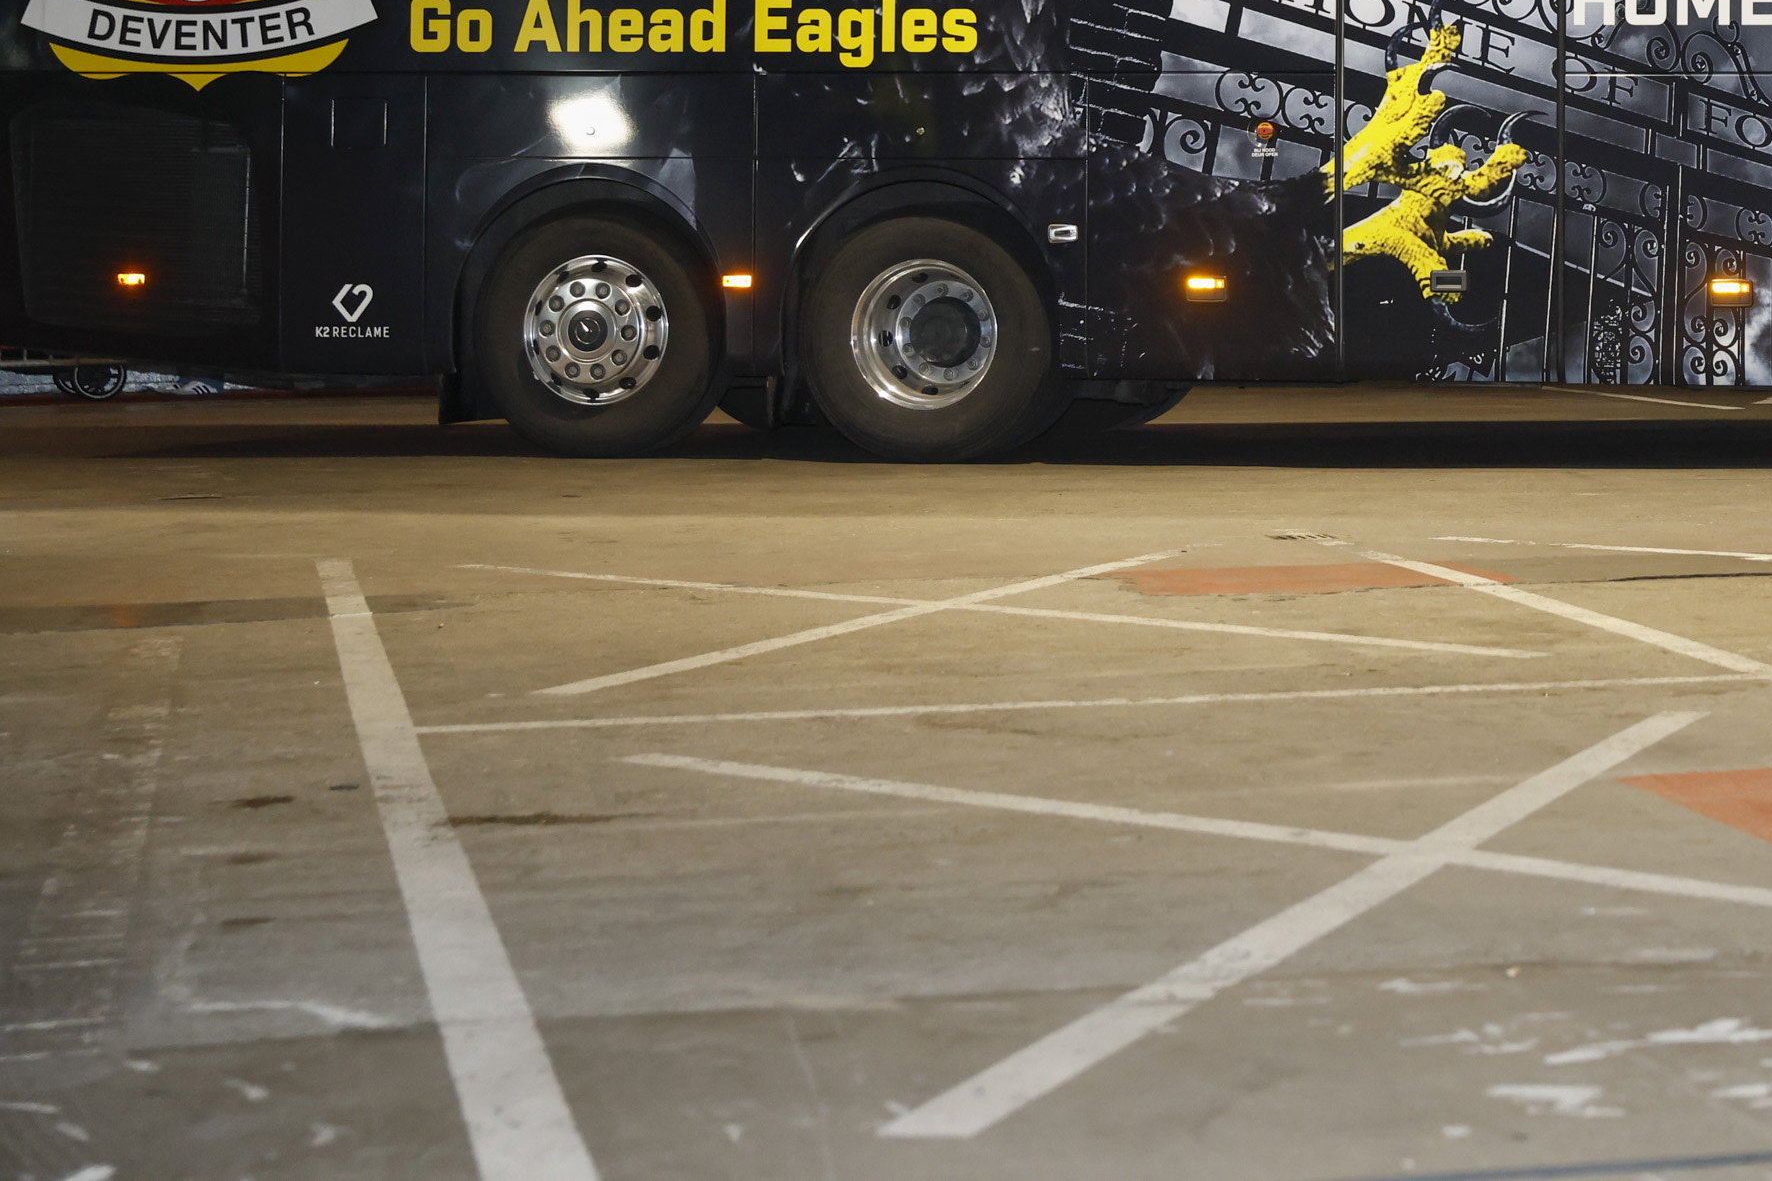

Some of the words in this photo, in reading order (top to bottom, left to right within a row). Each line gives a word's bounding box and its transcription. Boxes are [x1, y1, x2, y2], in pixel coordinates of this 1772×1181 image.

[87, 6, 315, 51] DEVENTER
[315, 326, 330, 338] K2
[332, 326, 390, 338] RECLAME
